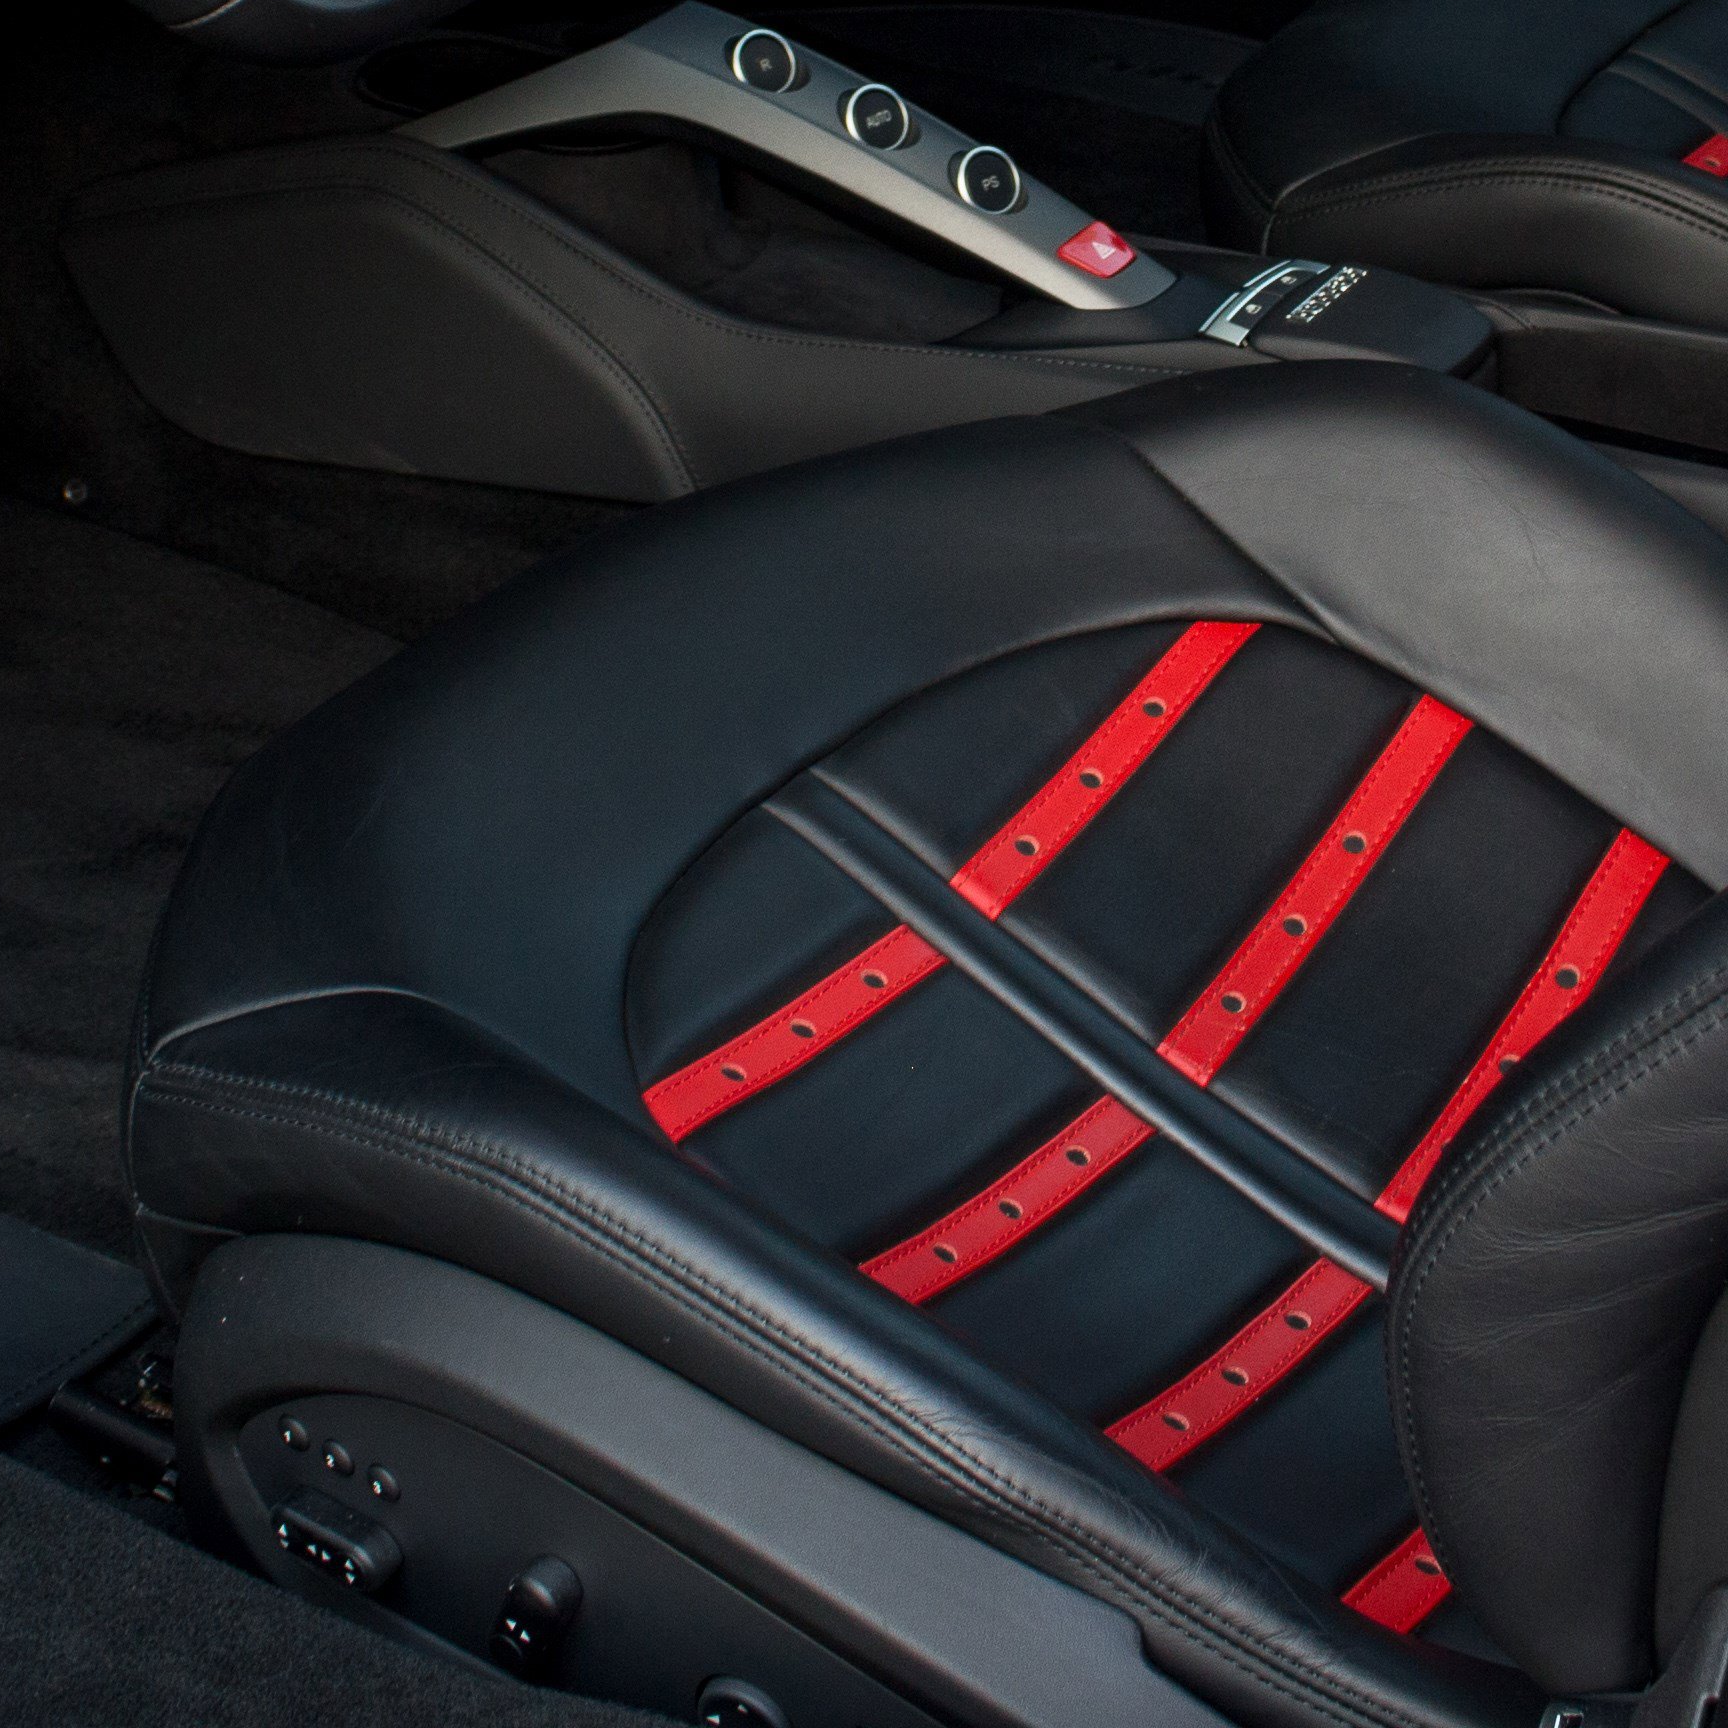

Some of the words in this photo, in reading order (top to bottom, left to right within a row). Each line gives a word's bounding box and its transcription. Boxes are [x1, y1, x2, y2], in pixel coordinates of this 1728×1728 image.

[760, 58, 772, 72] R
[866, 109, 892, 129] AUTO
[981, 175, 1001, 191] PS
